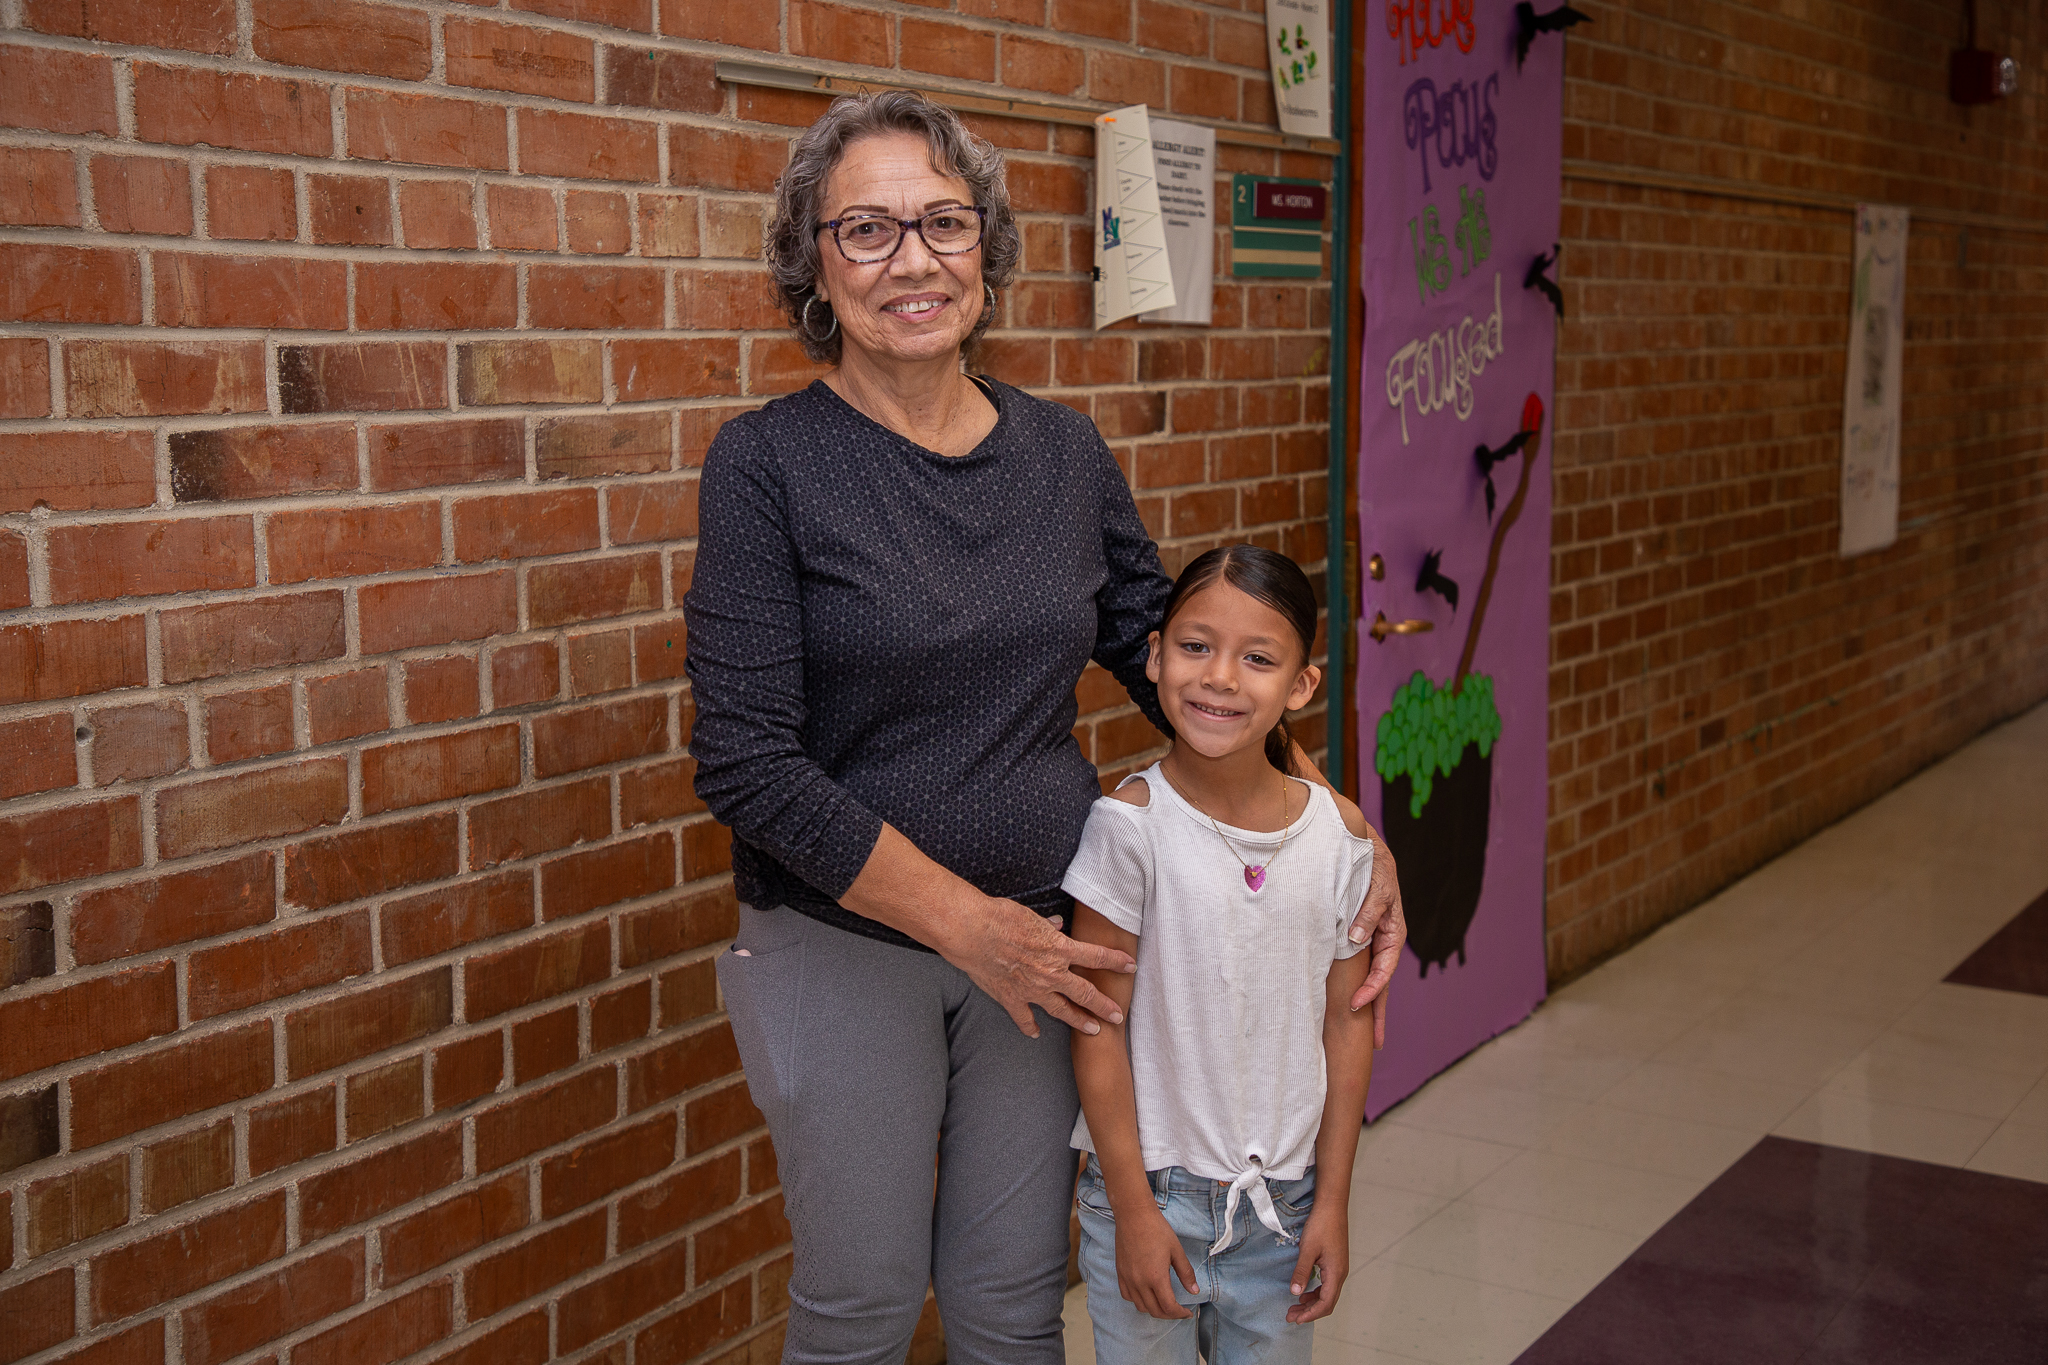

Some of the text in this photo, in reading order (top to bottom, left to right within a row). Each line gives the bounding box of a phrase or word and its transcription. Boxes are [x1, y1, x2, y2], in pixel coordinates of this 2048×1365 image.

[1237, 184, 1247, 203] 2
[1403, 71, 1499, 194] Pocus
[1386, 271, 1503, 447] Focused
